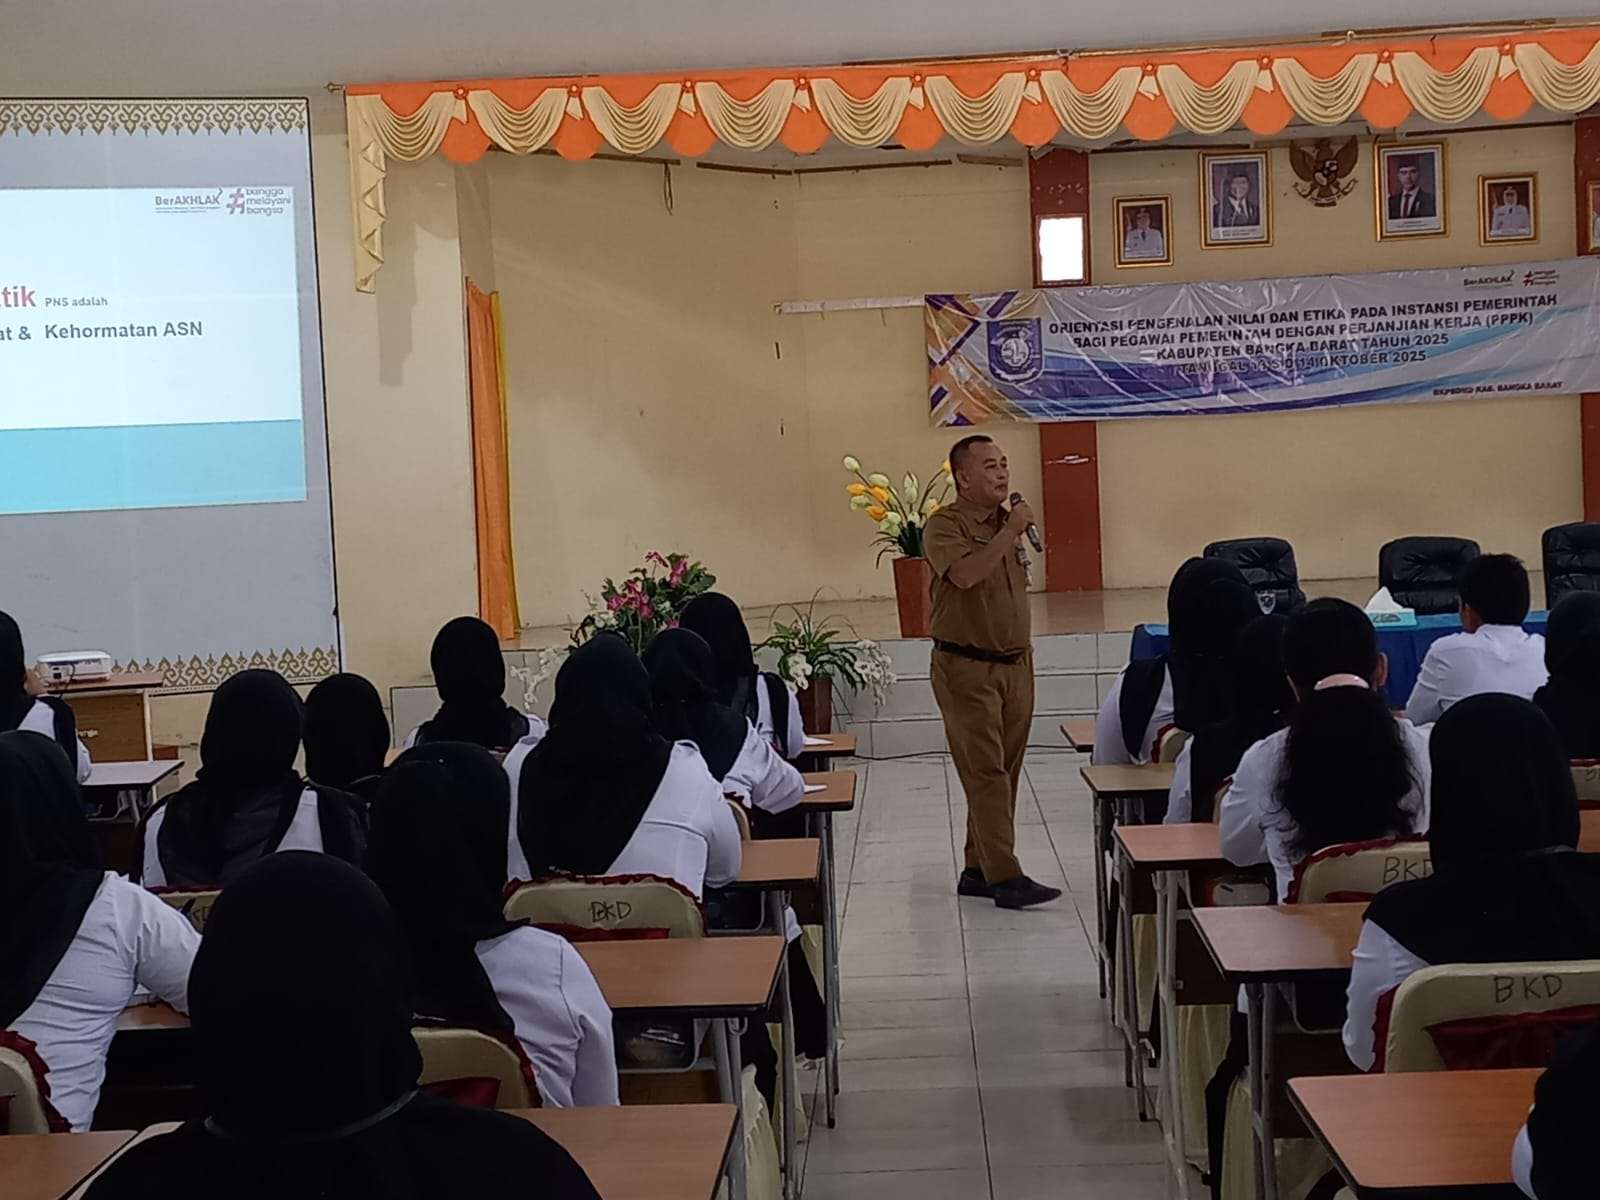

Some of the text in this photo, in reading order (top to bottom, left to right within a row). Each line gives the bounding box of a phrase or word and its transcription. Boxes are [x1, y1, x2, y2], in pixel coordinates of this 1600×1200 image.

[155, 195, 220, 205] BerAKHLAK
[246, 188, 284, 197] bangga
[246, 196, 291, 206] melayani
[246, 206, 284, 216] bangsa
[0, 285, 108, 308] tik PNS adalah
[1049, 294, 1558, 334] ORIENTASI PENGENALAN NILAI DAN ETIKA PADA INSTANSI PEMERINTAH
[18, 326, 32, 341] &
[45, 323, 158, 339] Kehormatan
[163, 320, 202, 337] ASN
[1111, 333, 1175, 347] PEGAWAI
[1275, 324, 1335, 339] DENGAN
[1340, 319, 1429, 335] PERJANJIAN
[1434, 315, 1482, 330] KERJA
[1486, 311, 1534, 328] (PPPK)
[1157, 333, 1449, 360] KABUPATEN BANGKA BARAT TAHUN 2025
[1319, 352, 1388, 366] OKTOBER
[1392, 350, 1426, 363] 2025
[1494, 974, 1563, 1003] BKD
